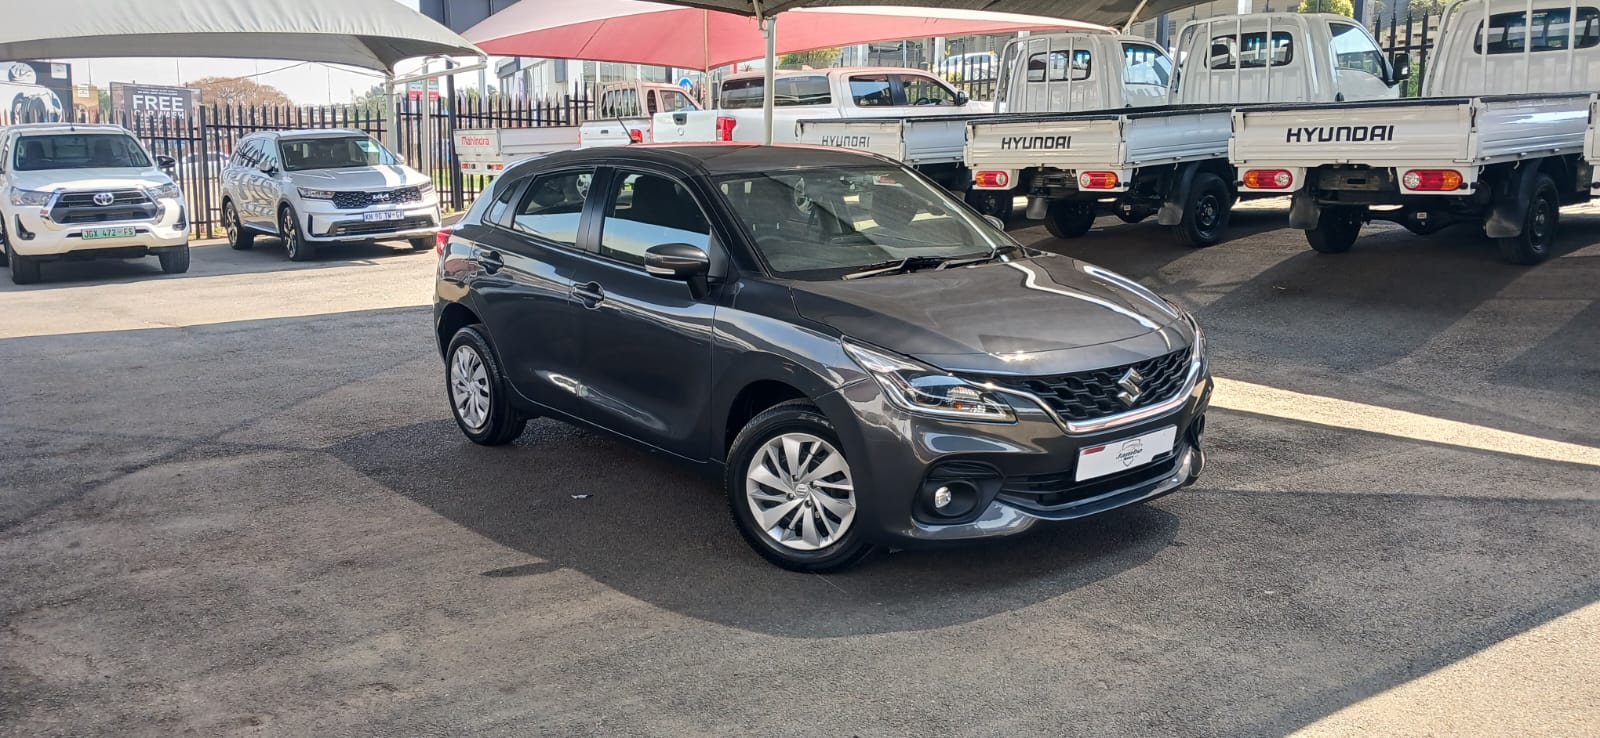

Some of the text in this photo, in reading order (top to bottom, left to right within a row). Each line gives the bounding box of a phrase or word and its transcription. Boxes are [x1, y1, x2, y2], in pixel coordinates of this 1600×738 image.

[132, 94, 184, 112] FREE
[461, 136, 490, 146] Mahindra
[821, 135, 870, 147] HYUNDAI
[1286, 125, 1394, 143] HYUNDAI
[1001, 135, 1072, 150] HYUNDAI
